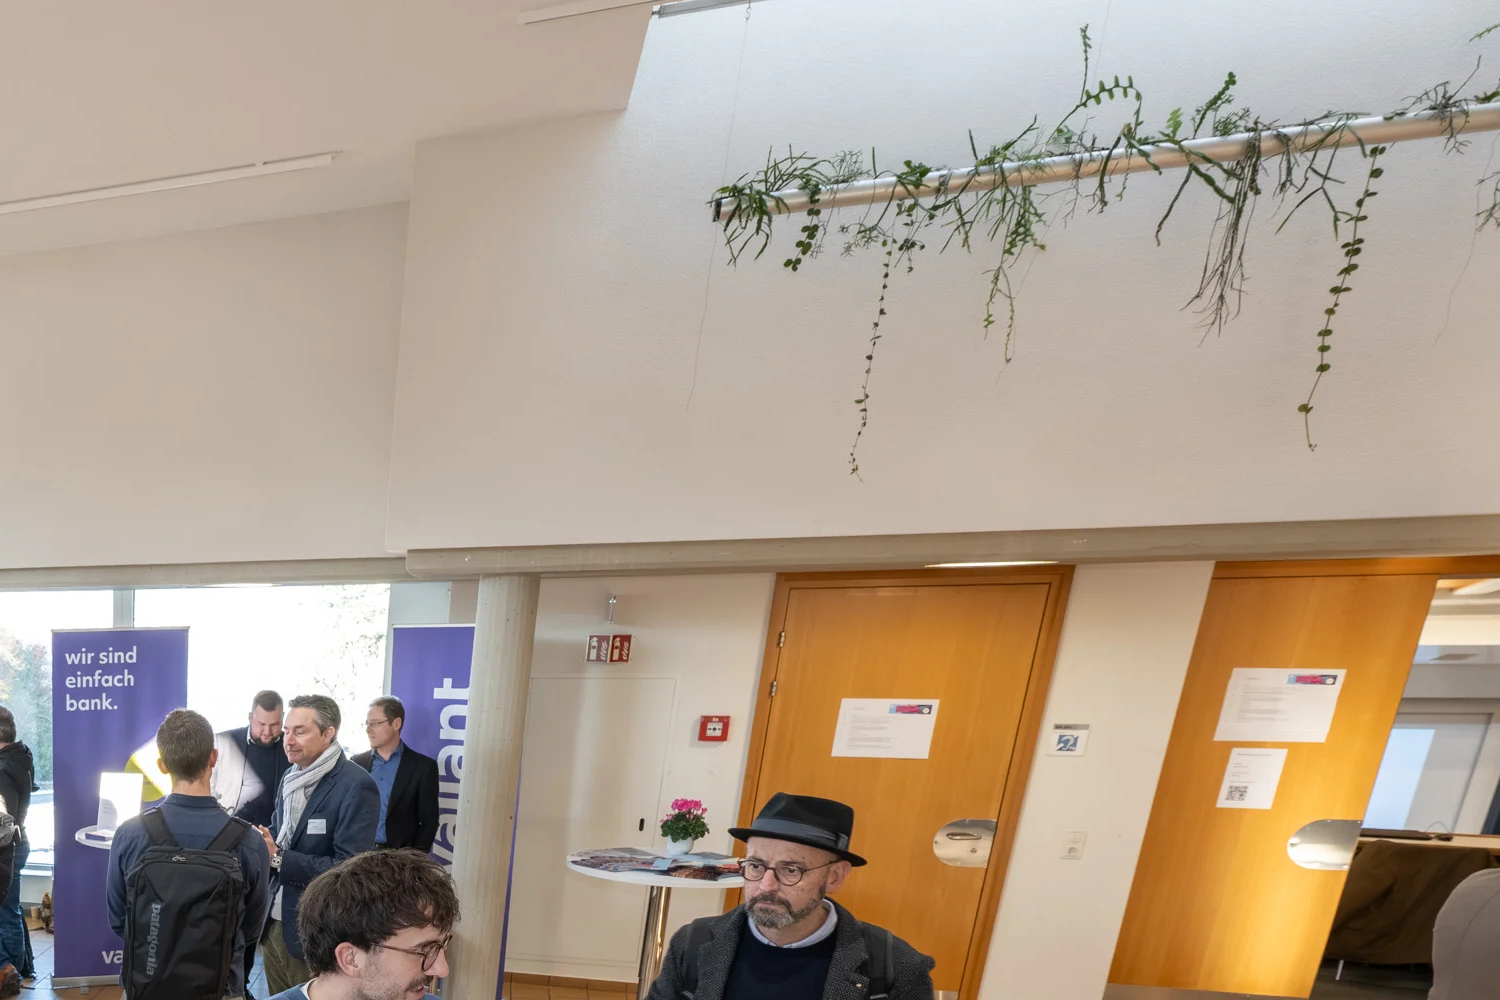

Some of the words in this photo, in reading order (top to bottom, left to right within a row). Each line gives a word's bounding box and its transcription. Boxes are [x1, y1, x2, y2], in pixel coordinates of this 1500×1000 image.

[65, 648, 94, 664] wir
[99, 645, 137, 664] sind
[65, 669, 134, 688] einfach
[66, 692, 118, 711] bank.
[146, 902, 161, 976] patagonia
